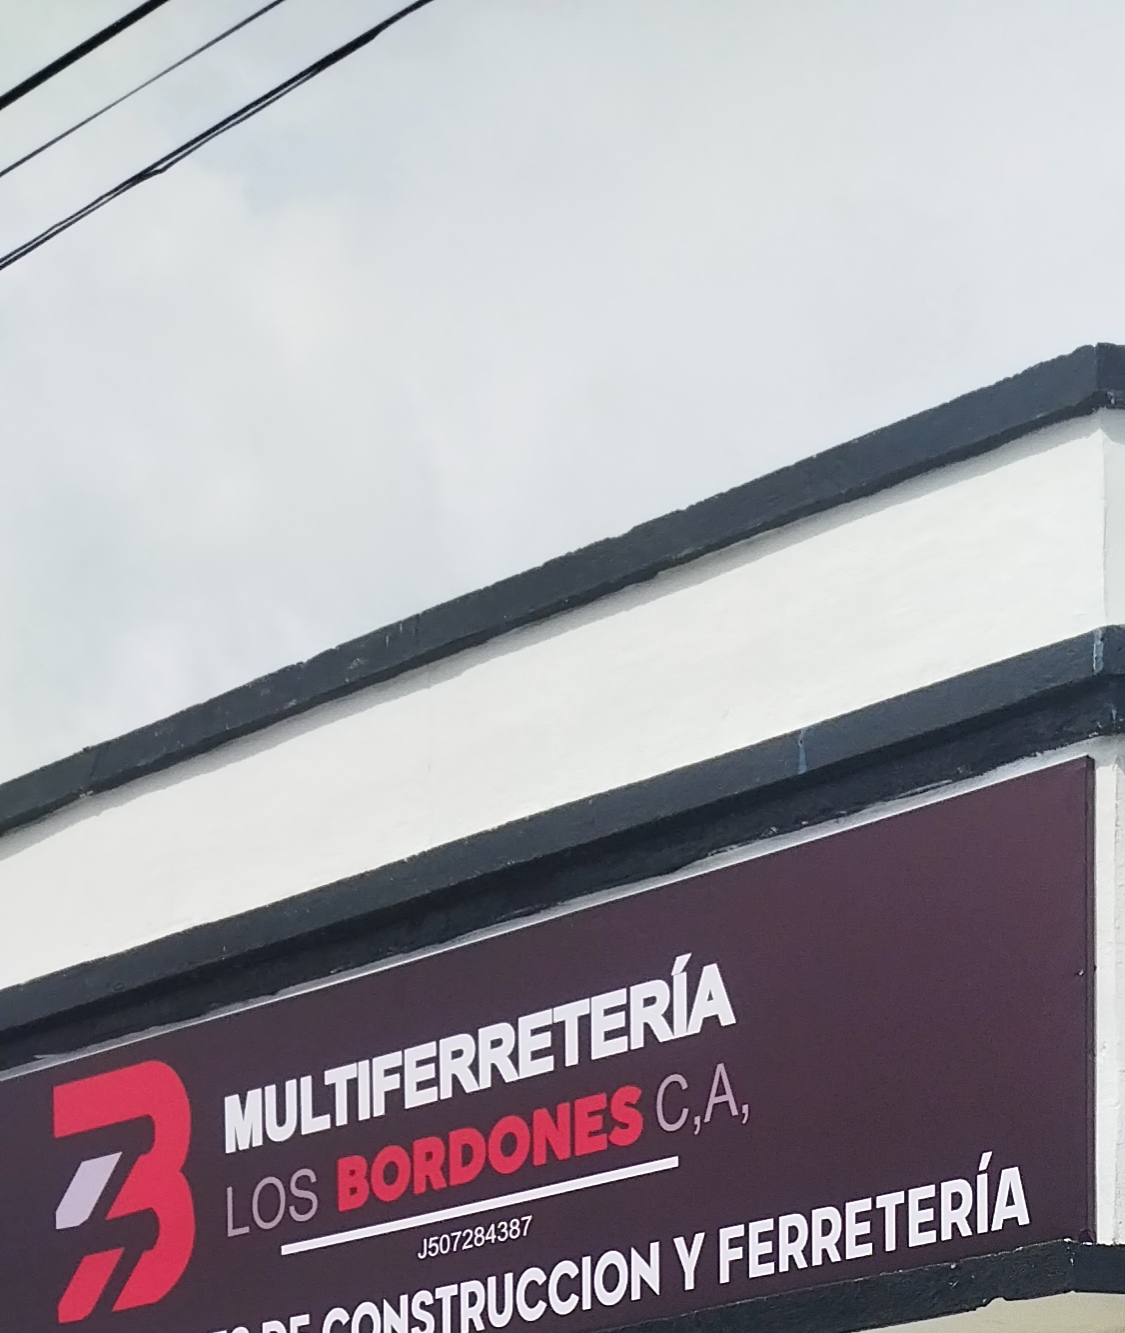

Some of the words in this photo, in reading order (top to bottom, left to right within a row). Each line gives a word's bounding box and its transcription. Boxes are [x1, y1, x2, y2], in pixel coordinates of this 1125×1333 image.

[223, 952, 737, 1154] MULTIFERRETERÍA
[226, 1168, 318, 1237] LOS
[336, 1085, 644, 1213] BORDONES
[672, 1231, 706, 1291] Y
[718, 1150, 1031, 1284] FERRETERÍA
[417, 1214, 533, 1260] J507284387
